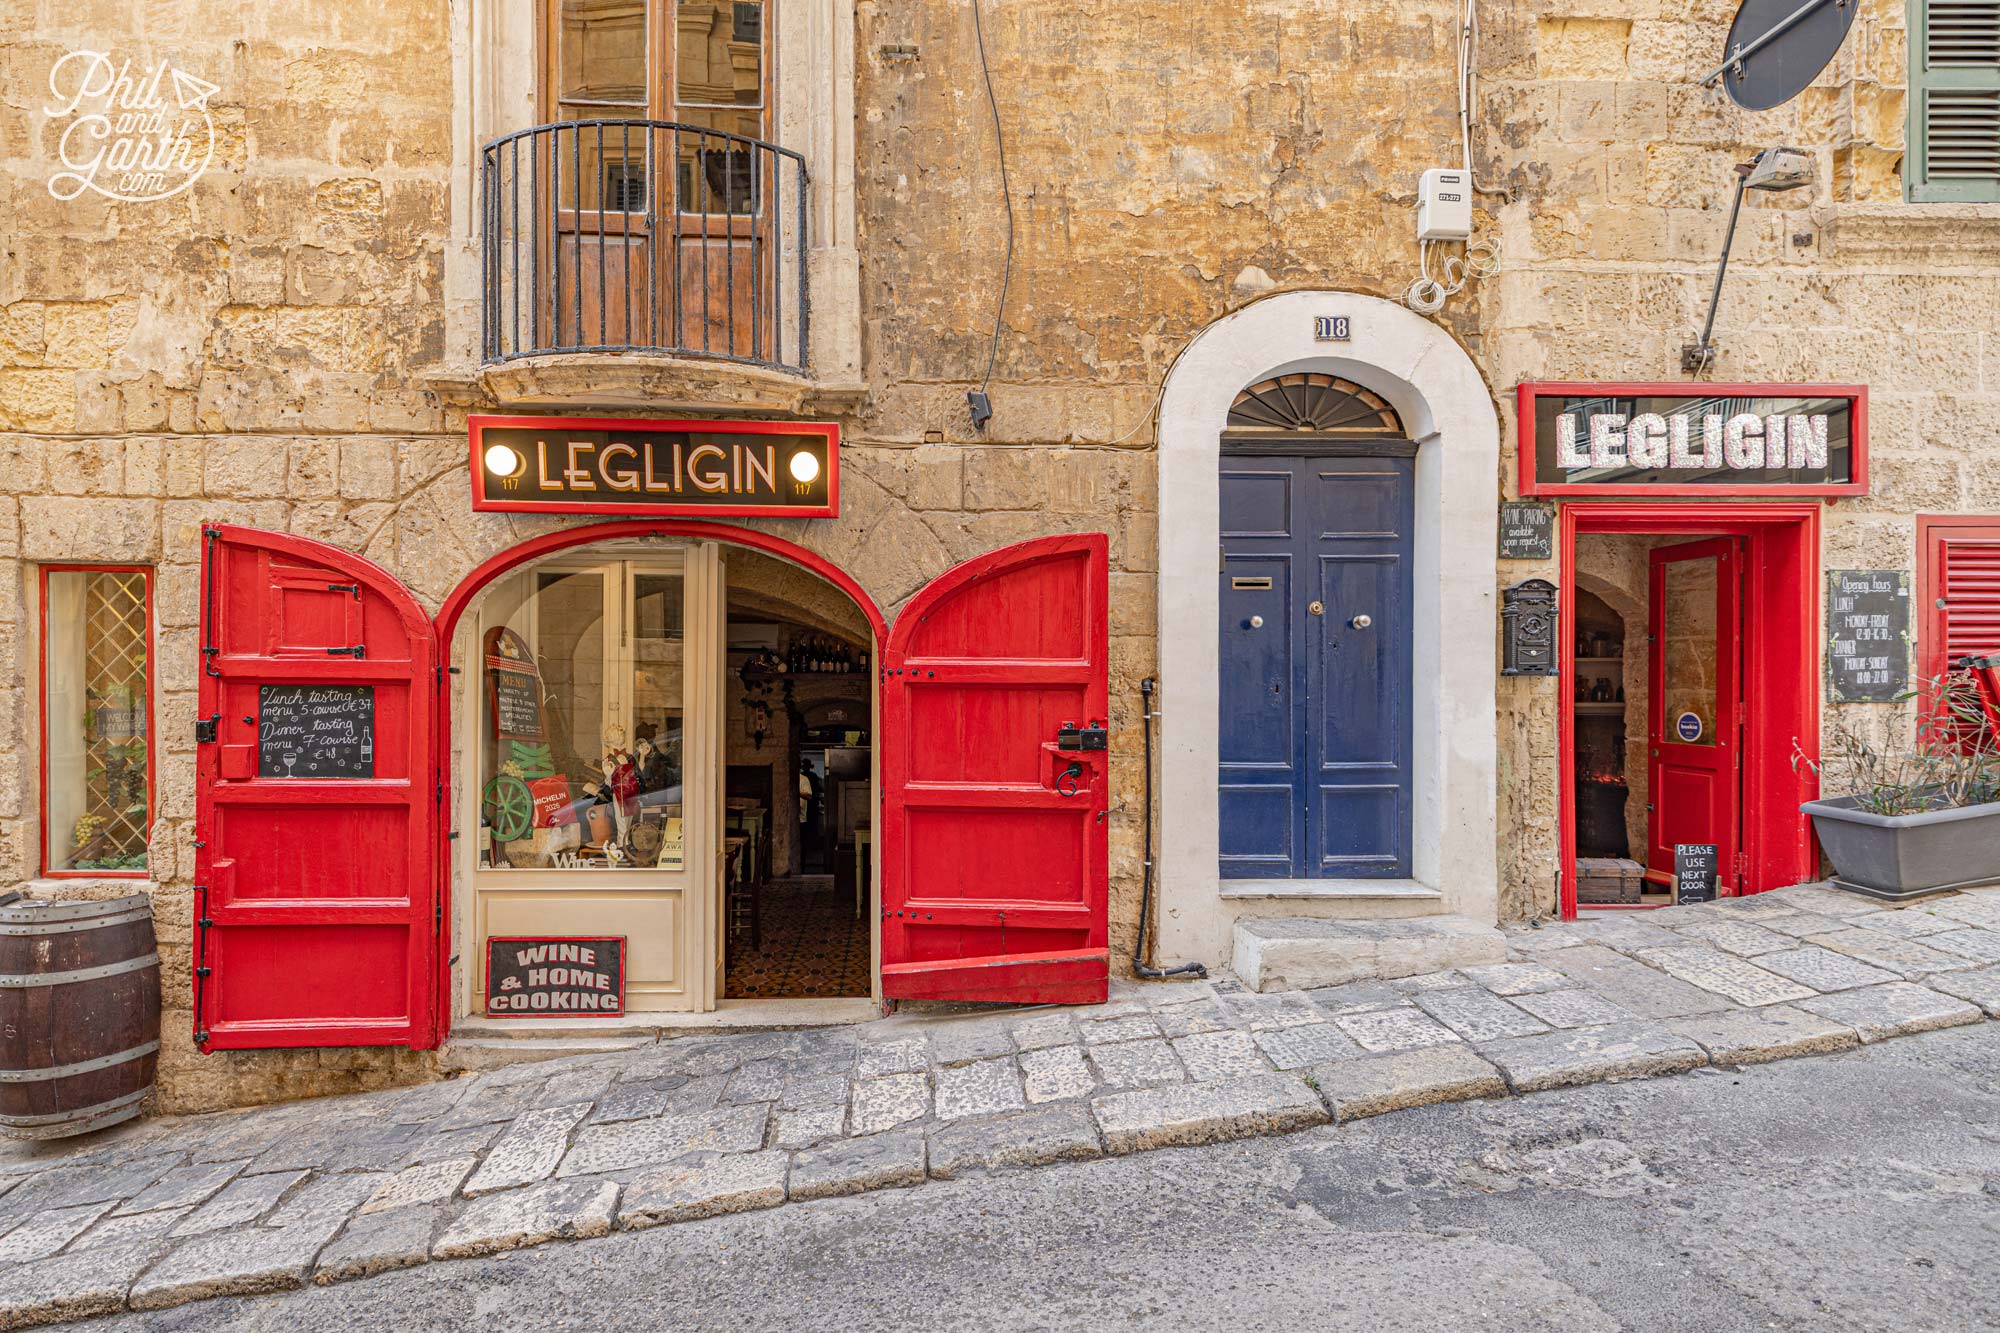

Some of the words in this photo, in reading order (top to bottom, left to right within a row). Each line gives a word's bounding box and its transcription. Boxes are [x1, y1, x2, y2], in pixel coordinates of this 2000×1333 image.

[1319, 318, 1348, 337] 118
[1556, 412, 1829, 470] LEGLIGIN
[536, 440, 776, 495] LEGLIGIN
[502, 478, 519, 490] 117
[794, 483, 811, 496] 117
[1504, 508, 1520, 525] WINE
[1842, 576, 1869, 594] Opening
[1872, 575, 1891, 590] hours
[1834, 597, 1854, 611] LUNCH
[1835, 640, 1857, 654] DINNER
[502, 676, 527, 688] MENU
[263, 688, 303, 705] Lunch
[308, 690, 352, 706] tasting
[263, 706, 293, 717] menu
[301, 703, 342, 716] 5-course
[260, 722, 305, 741] Dinner
[312, 719, 354, 736] tasting
[263, 740, 292, 752] menu
[303, 734, 358, 748] 7-course
[533, 792, 567, 805] MICHELIN
[544, 803, 561, 812] 2026
[1677, 844, 1714, 856] PLEASE
[551, 852, 596, 869] Wine
[1685, 858, 1706, 868] USE
[1681, 870, 1708, 880] NEXT
[1680, 881, 1706, 890] DOOR
[516, 943, 597, 967] WINE
[500, 975, 522, 992] &
[528, 967, 611, 991] HOME
[489, 991, 620, 1011] COOKING
